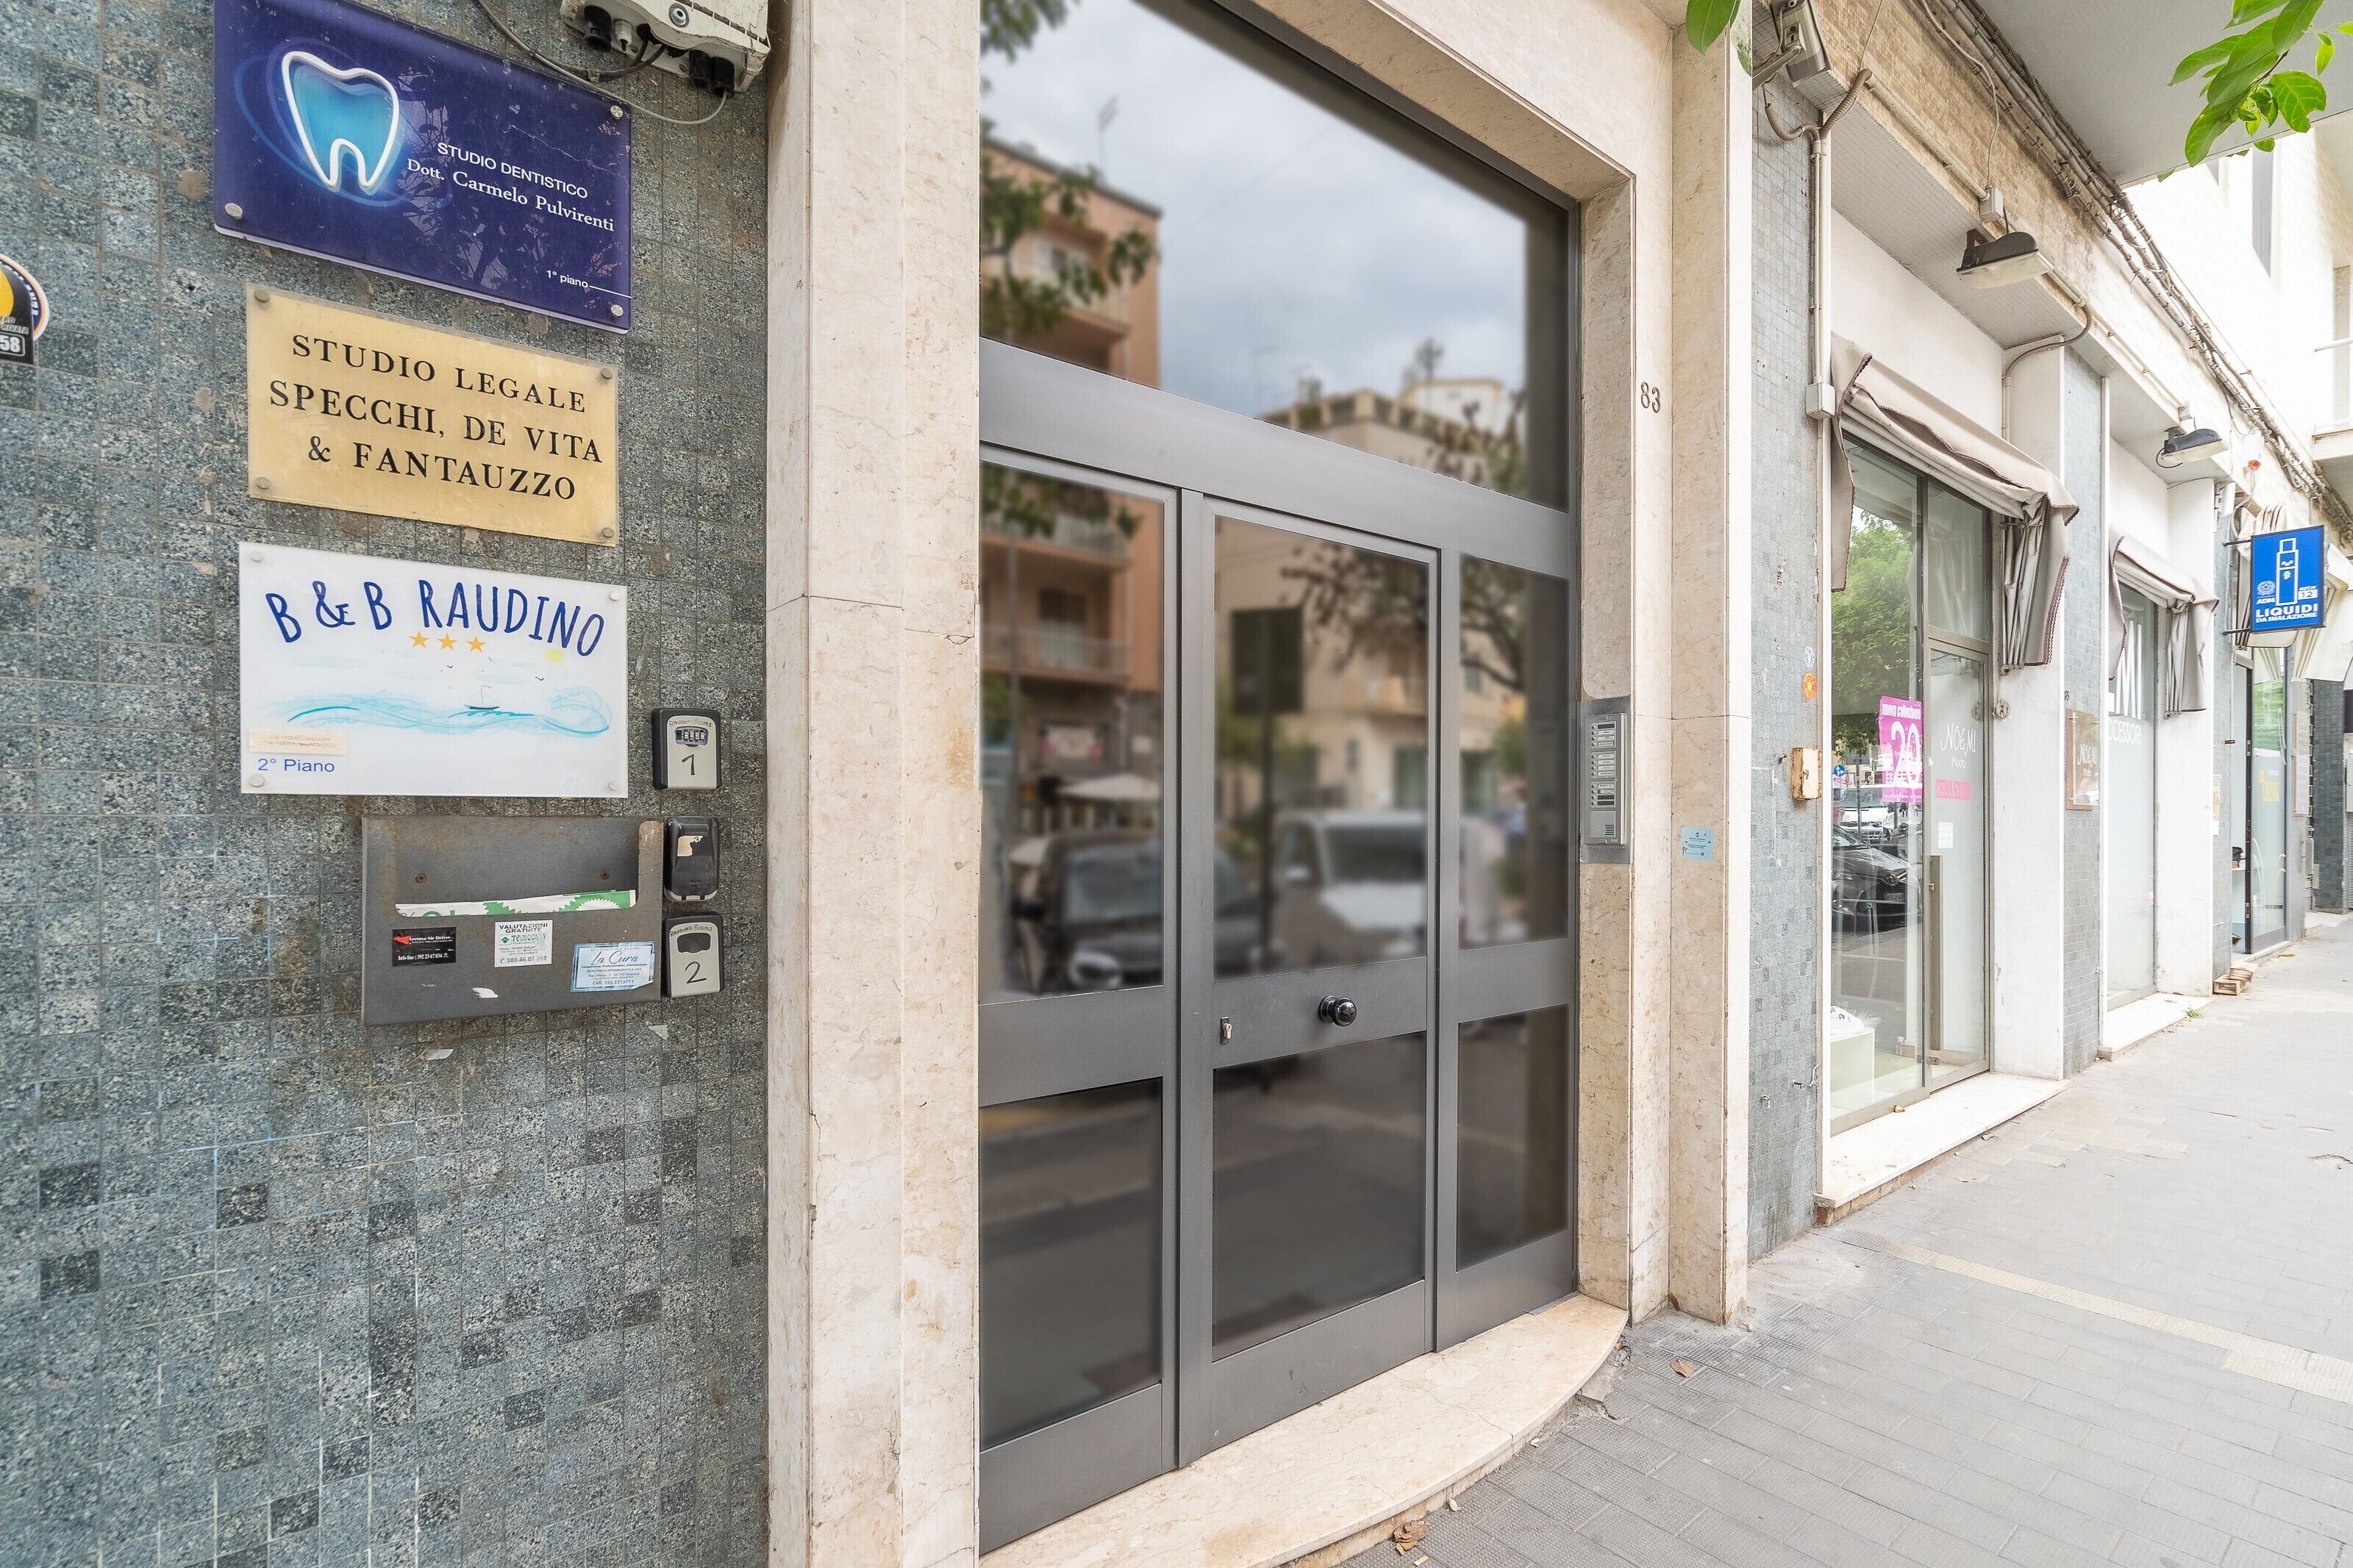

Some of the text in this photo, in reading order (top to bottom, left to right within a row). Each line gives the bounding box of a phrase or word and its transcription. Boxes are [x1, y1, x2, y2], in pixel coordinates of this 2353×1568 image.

[437, 142, 588, 199] STUDIO DENTISTICO
[407, 158, 615, 232] Dott. Carmelo Pulvirenti
[546, 270, 589, 290] 1° piano
[293, 334, 585, 413] STUDIO LEGALE
[1640, 382, 1661, 413] 83
[270, 380, 602, 464] SPECCHI, DE VITA
[307, 436, 575, 501] & FANTAUZZO
[265, 579, 605, 656] B & B RAUDINO
[2256, 603, 2318, 617] LIQUIDI
[2268, 612, 2318, 622] INALAZIONE
[2108, 717, 2142, 746] CCESSORI
[258, 758, 335, 773] 2° Piano
[590, 950, 640, 965] La Cura
[685, 961, 707, 984] 2
